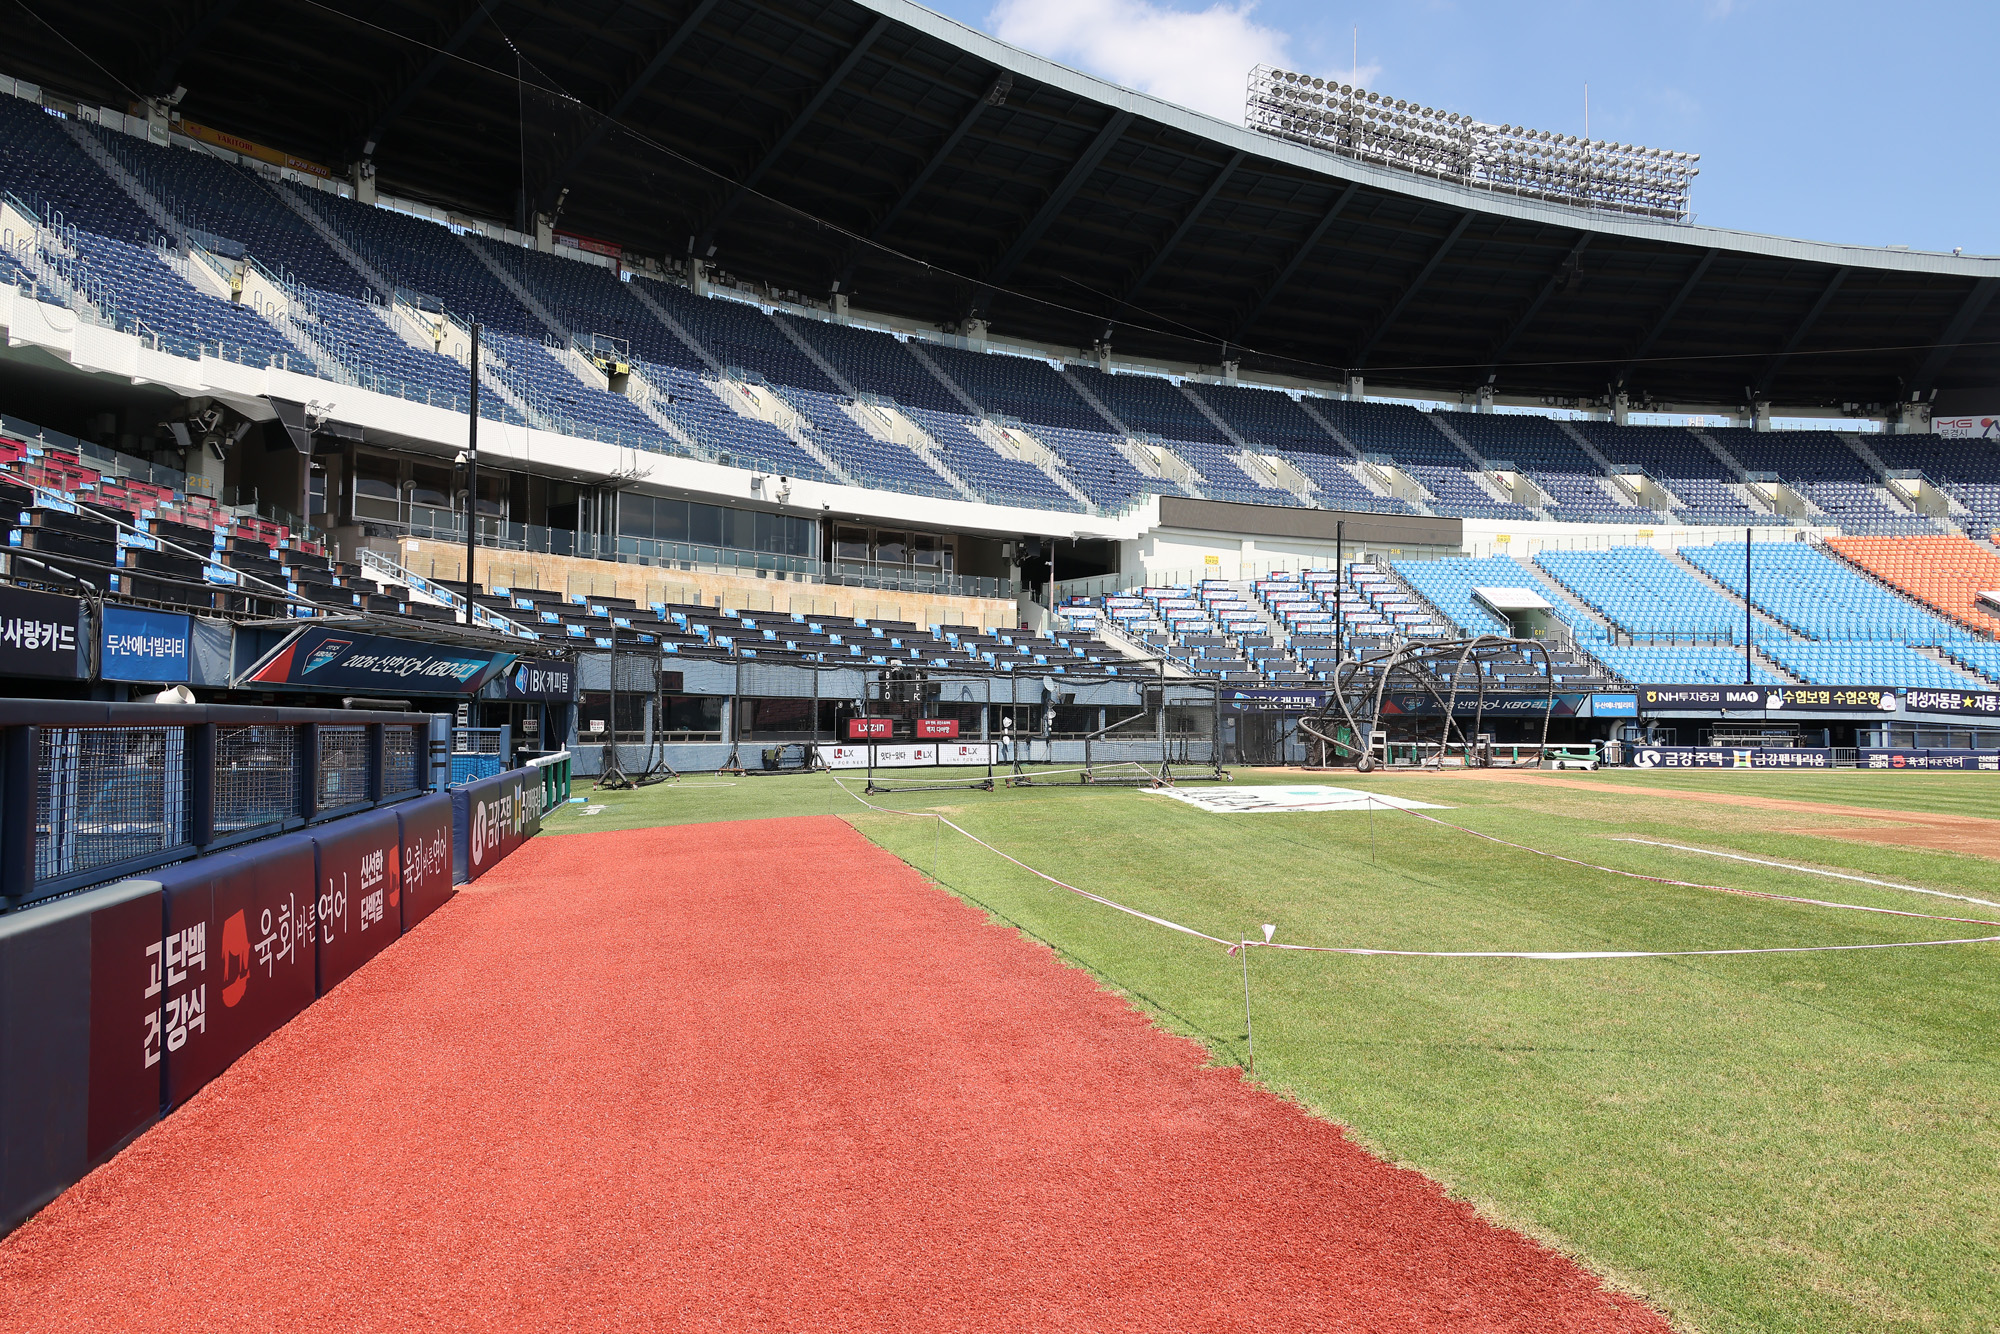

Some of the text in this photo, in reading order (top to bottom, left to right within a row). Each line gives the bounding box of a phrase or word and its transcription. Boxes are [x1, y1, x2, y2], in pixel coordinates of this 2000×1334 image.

[216, 133, 254, 152] YAKITORI
[1937, 419, 1972, 429] MG
[189, 476, 210, 488] 213
[106, 635, 185, 658] 두산에너빌리티
[341, 654, 378, 668] 2026
[885, 671, 890, 679] B
[913, 693, 920, 701] FC
[1658, 691, 1720, 702] NH투자증권
[1782, 690, 1880, 705] 수협보험 수협은행
[1906, 691, 2000, 711] 태성자동문 자동
[1594, 701, 1635, 709] 두산에너빌리티
[858, 723, 869, 732] LX
[967, 747, 978, 755] LX
[1665, 752, 1825, 767] 금강주택 금강펜테리움
[488, 795, 512, 849] 금강주택
[360, 848, 383, 890] 신선한
[360, 887, 383, 932] 단백질
[144, 920, 206, 1000] 고단백
[143, 983, 206, 1069] 건강식
